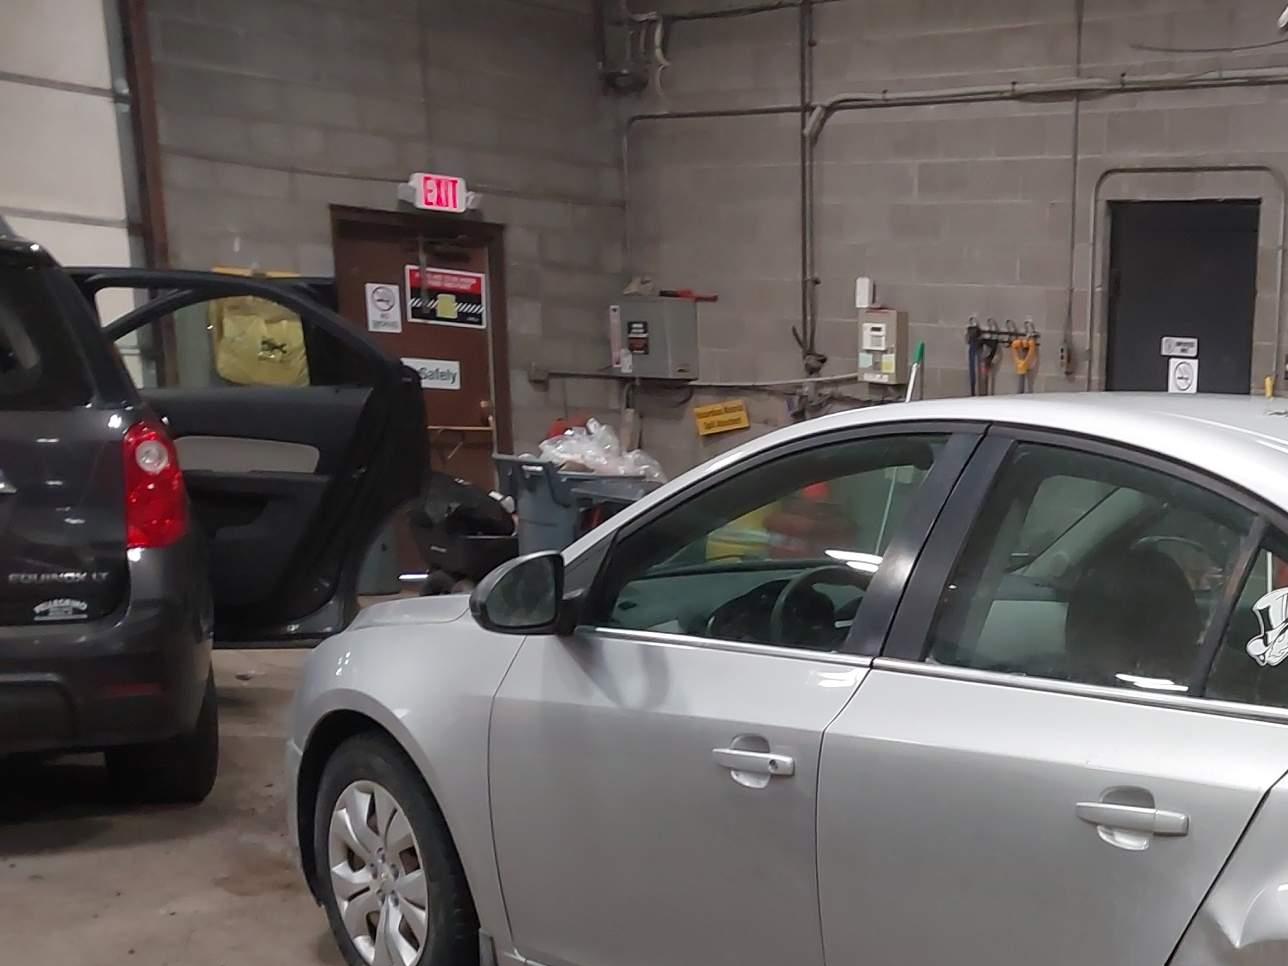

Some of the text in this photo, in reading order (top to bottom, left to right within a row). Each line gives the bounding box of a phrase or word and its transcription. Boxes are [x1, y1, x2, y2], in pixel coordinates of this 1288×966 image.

[423, 176, 459, 209] EXIT
[419, 367, 458, 385] Safely
[8, 571, 110, 584] EQUINOX LT
